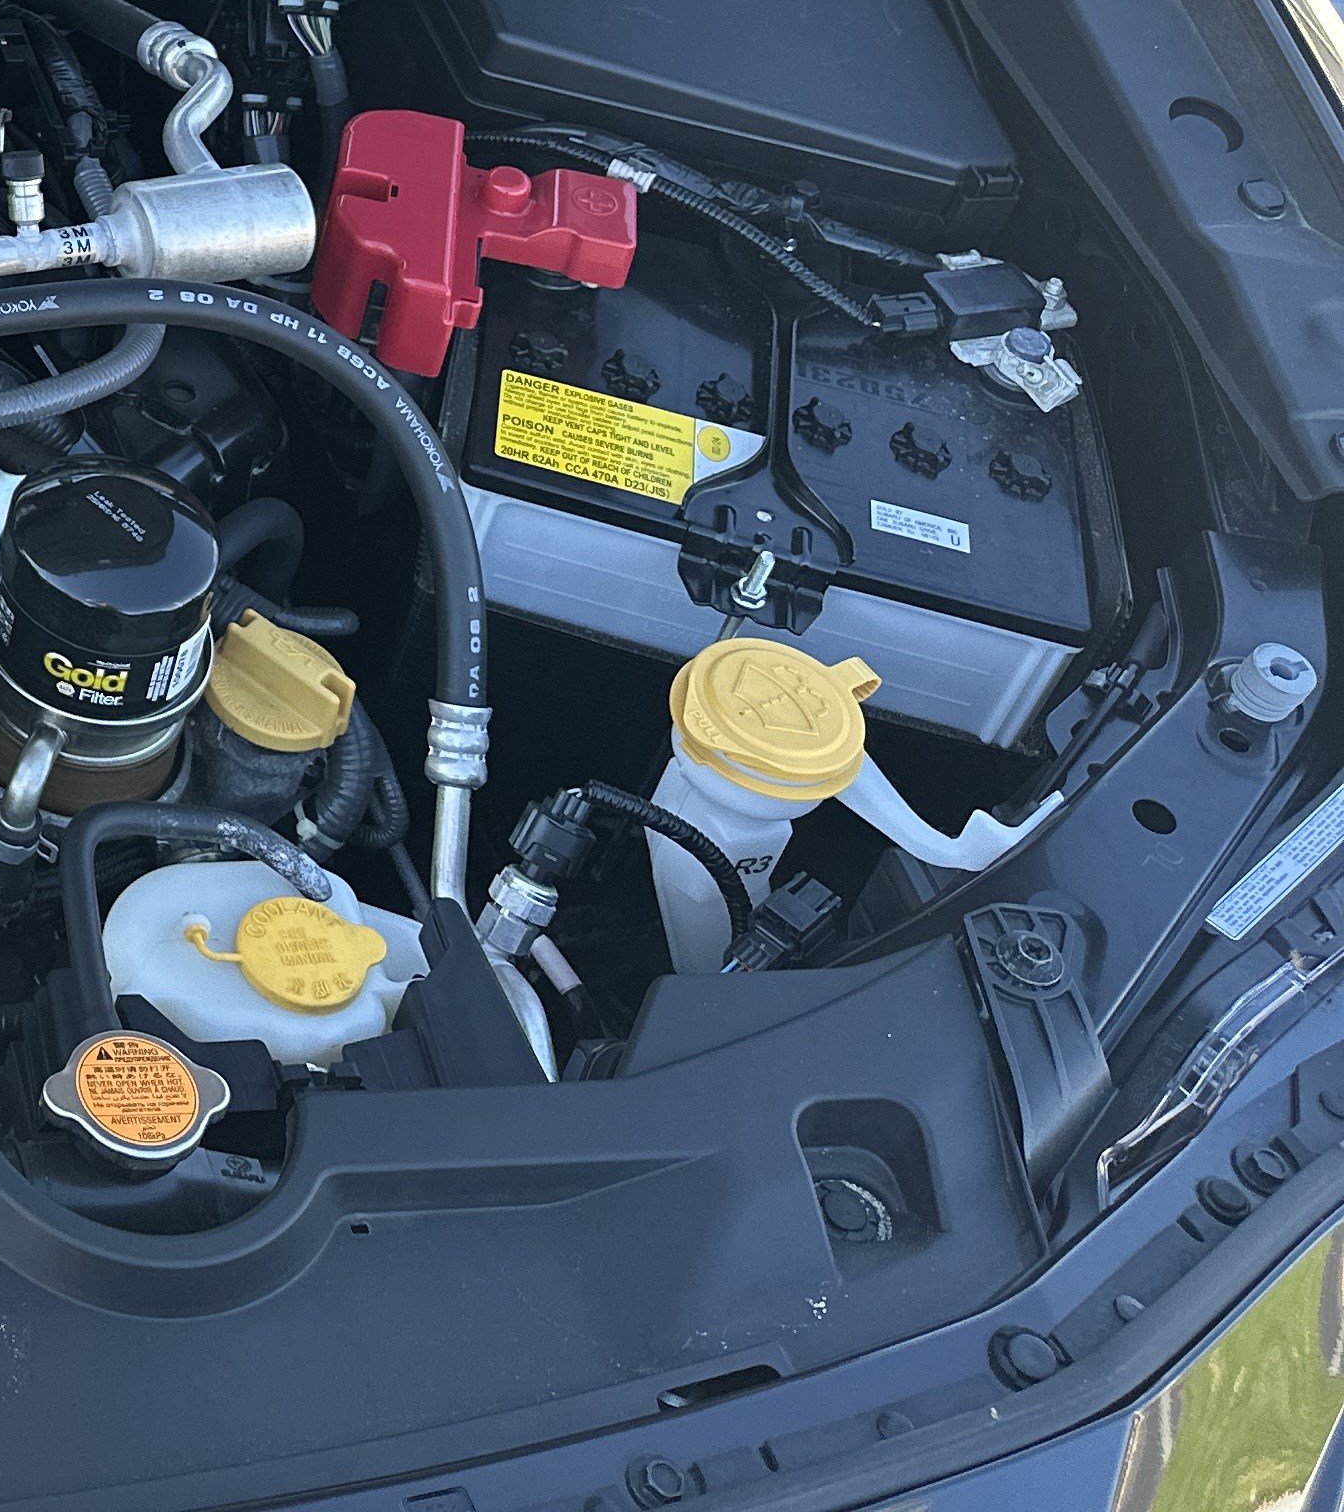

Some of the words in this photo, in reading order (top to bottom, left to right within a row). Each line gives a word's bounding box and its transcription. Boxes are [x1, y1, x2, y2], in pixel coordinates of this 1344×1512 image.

[224, 297, 259, 316] DA
[269, 312, 300, 332] HP
[505, 373, 559, 394] DANGER
[394, 394, 443, 473] YOKOHAMA
[502, 413, 553, 435] POISON
[542, 414, 563, 425] KEEP
[564, 419, 584, 431] VENT
[586, 425, 607, 437] CAPS
[608, 431, 631, 443] TIGHT
[632, 437, 649, 448] AND
[650, 442, 675, 456] LEVEL
[500, 444, 529, 461] 20HR
[531, 453, 559, 469] 62Ah
[563, 461, 588, 476] CCA
[591, 469, 618, 484] 470A
[624, 477, 671, 499] D23(JIS)
[43, 651, 129, 693] Gold
[78, 688, 123, 706] Filter
[243, 899, 347, 939] COOLANT
[111, 1115, 182, 1125] AVERTISSEMENT
